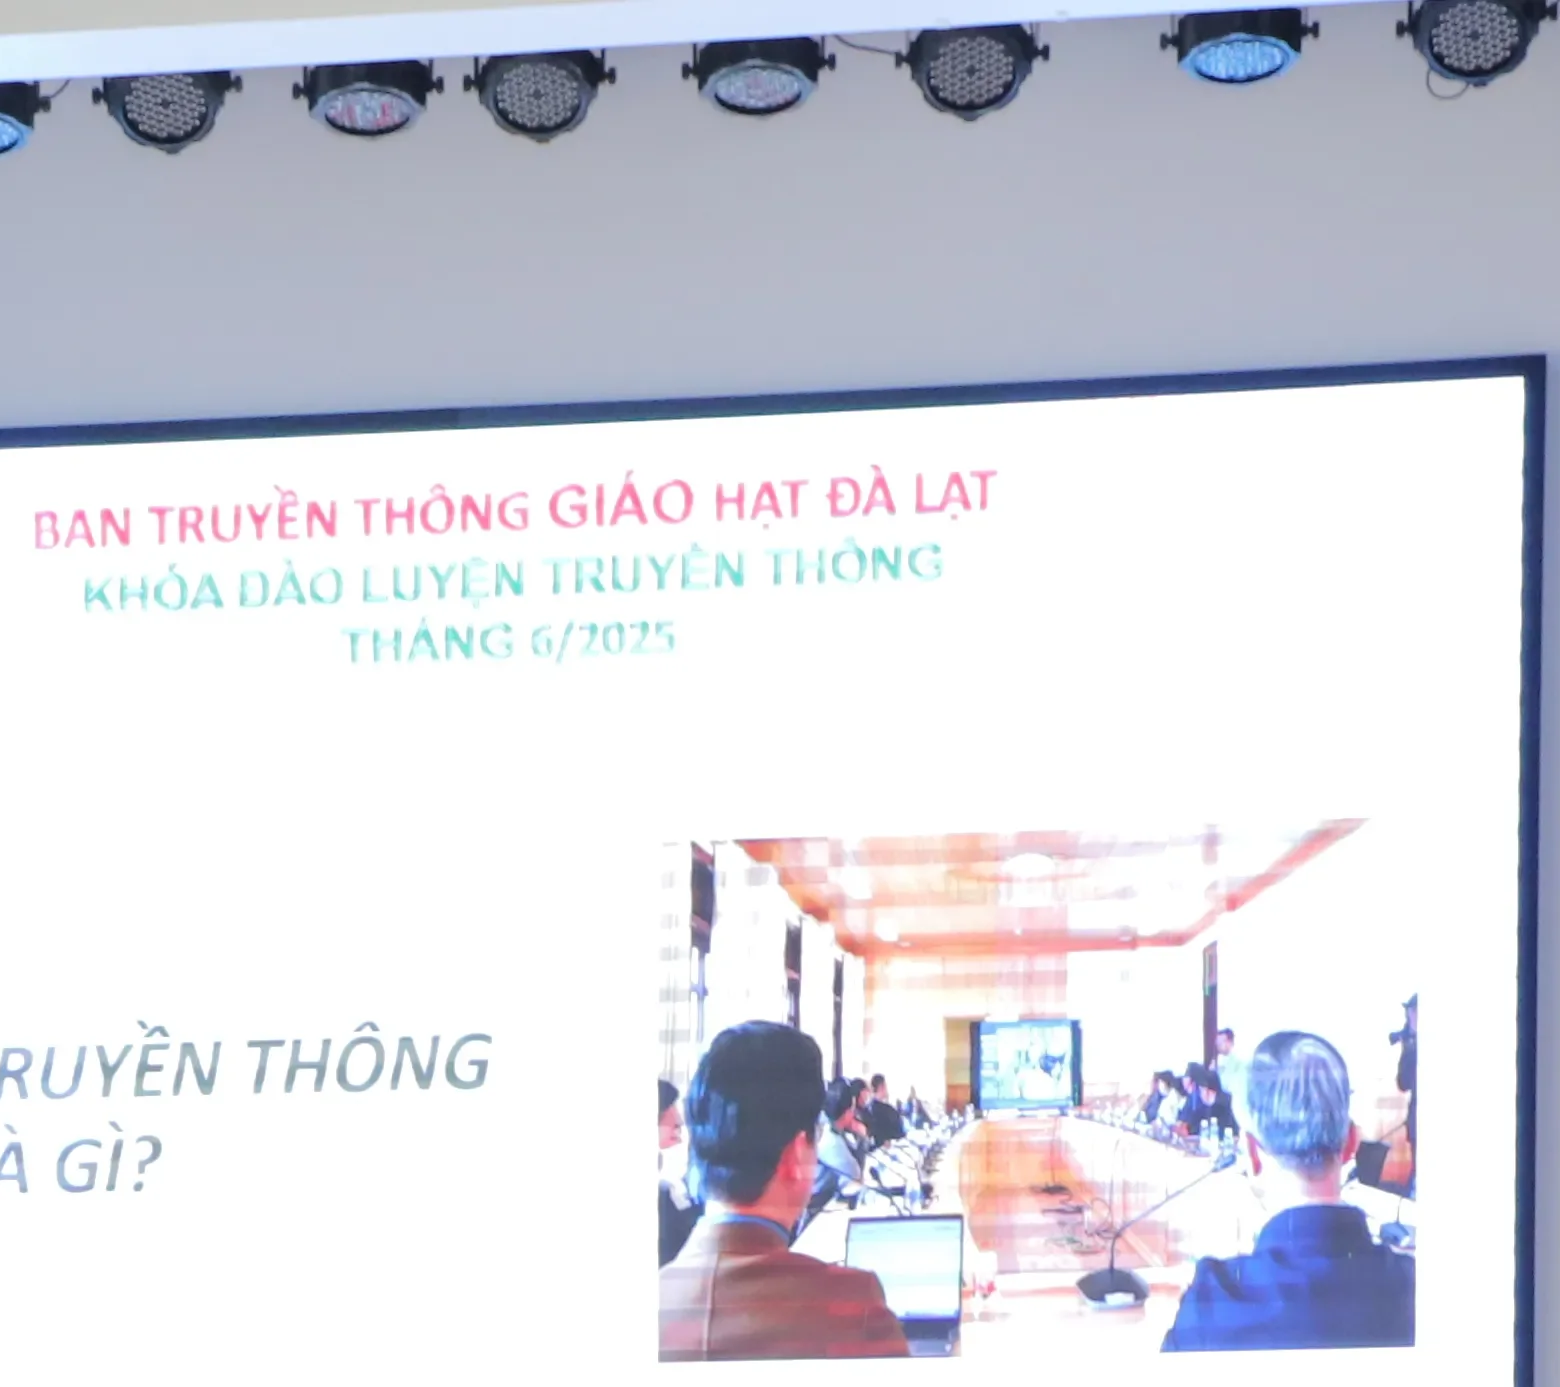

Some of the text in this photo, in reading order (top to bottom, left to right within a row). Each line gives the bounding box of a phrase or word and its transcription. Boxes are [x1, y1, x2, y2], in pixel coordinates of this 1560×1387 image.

[34, 463, 998, 550] BAN TRUYỀN THÔNG GIÁO HẠT ĐÀ LẠT
[83, 562, 225, 613] KHÓA
[341, 616, 676, 664] THÁNG 6/2025
[246, 1020, 493, 1095] THÔNG
[56, 1120, 163, 1194] GÌ?
